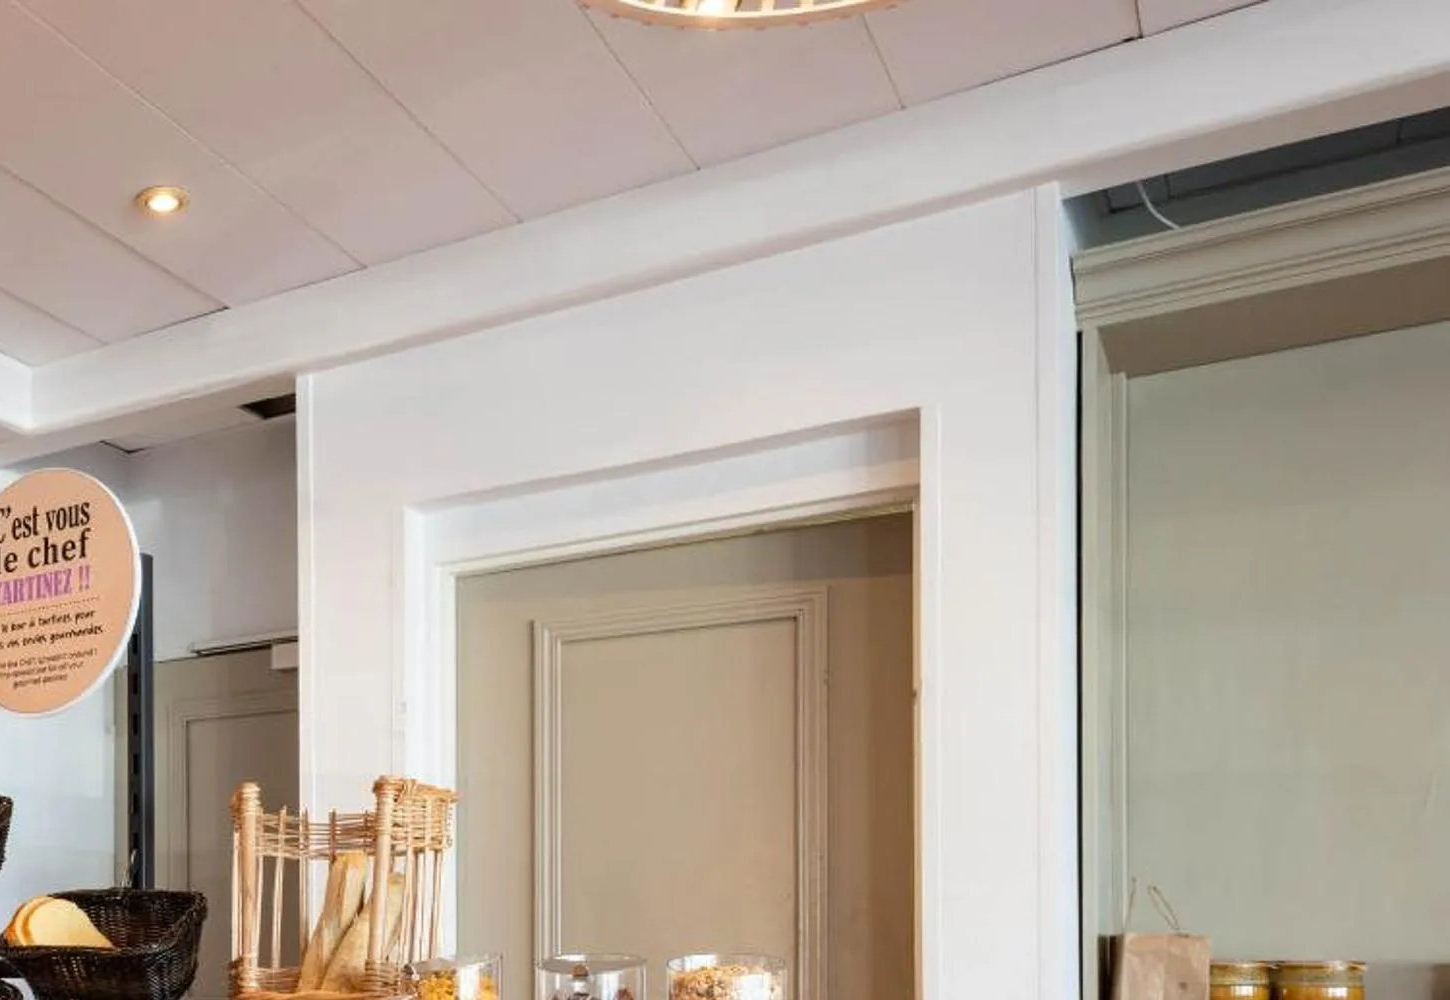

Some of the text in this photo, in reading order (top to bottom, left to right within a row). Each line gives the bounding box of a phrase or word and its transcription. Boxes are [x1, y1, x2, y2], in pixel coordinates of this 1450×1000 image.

[46, 501, 90, 532] vous
[27, 527, 91, 569] chef
[74, 610, 95, 625] pour
